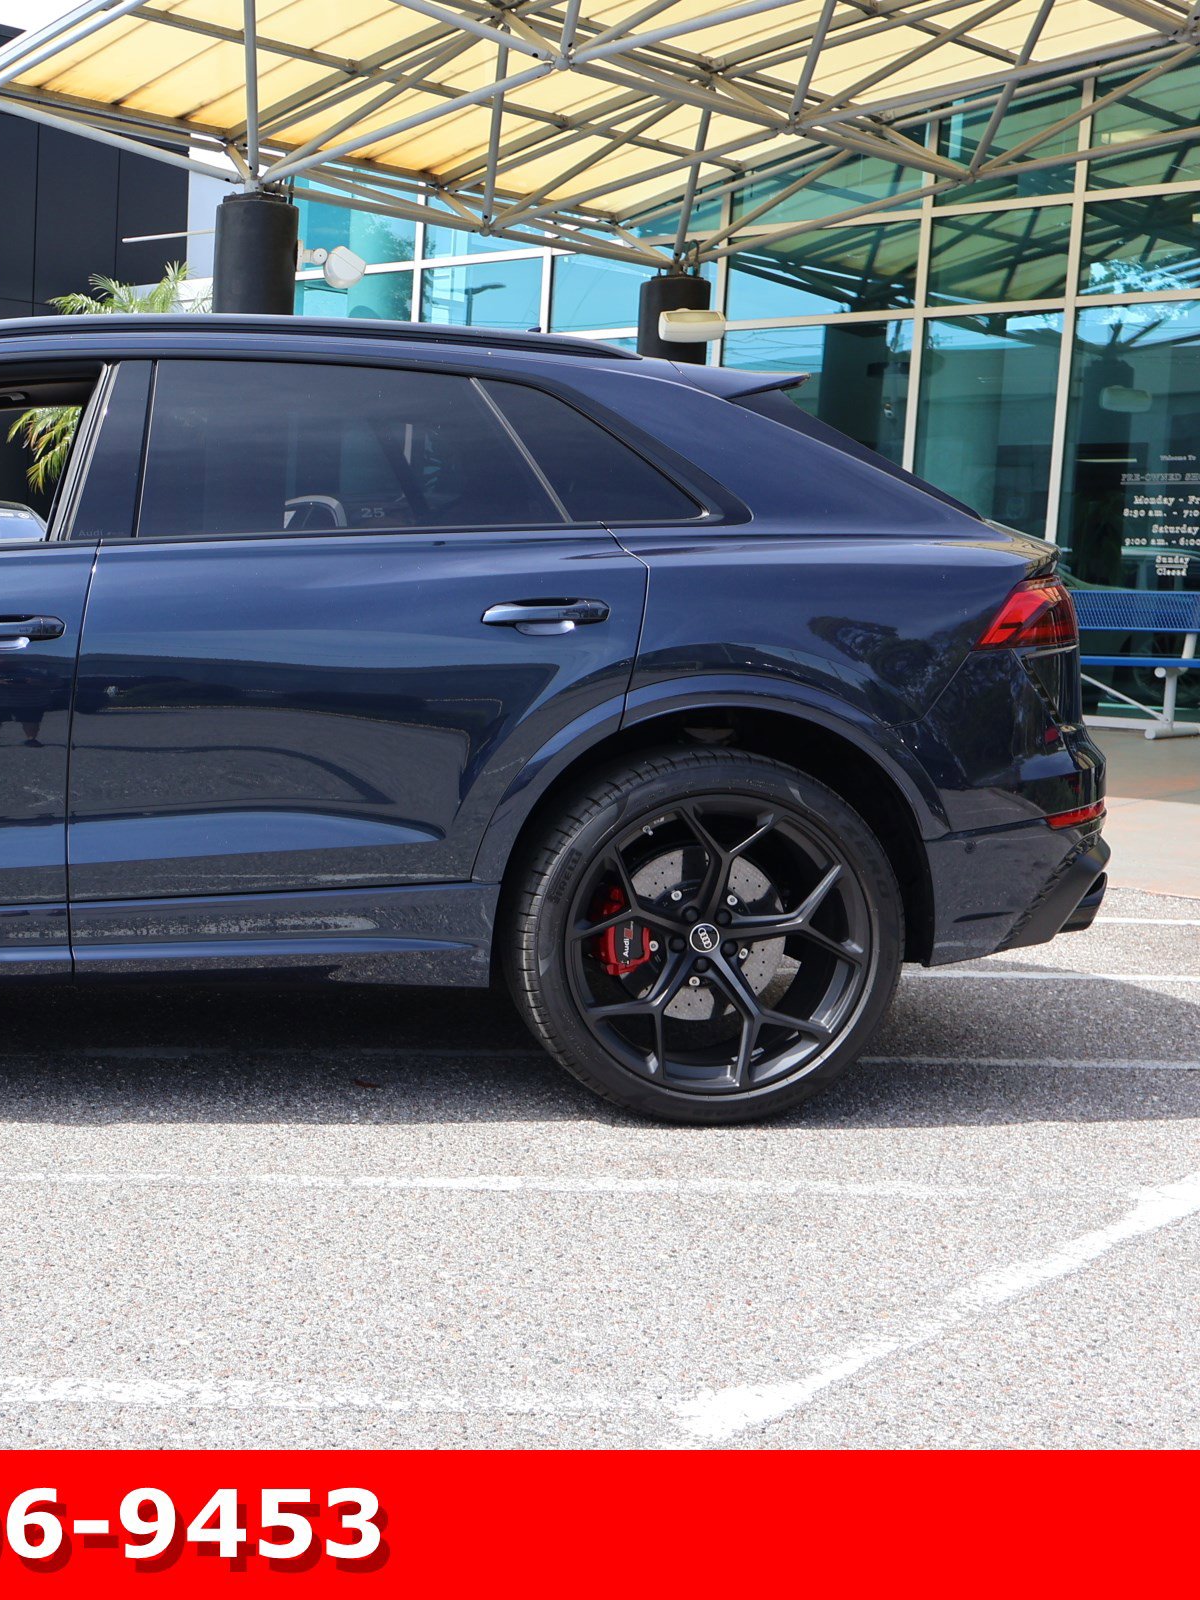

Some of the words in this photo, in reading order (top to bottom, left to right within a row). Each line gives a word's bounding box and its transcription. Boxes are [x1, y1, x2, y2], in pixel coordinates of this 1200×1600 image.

[1121, 473, 1182, 482] PRE-OWNED
[1133, 495, 1175, 507] Monday
[361, 507, 385, 518] 25
[1123, 508, 1146, 518] 8:30
[1148, 509, 1167, 517] am.
[1151, 524, 1200, 536] Saturday
[1124, 538, 1147, 546] 9:00
[1155, 555, 1190, 565] Sunday
[1156, 568, 1187, 576] Closed
[622, 938, 630, 957] Audi
